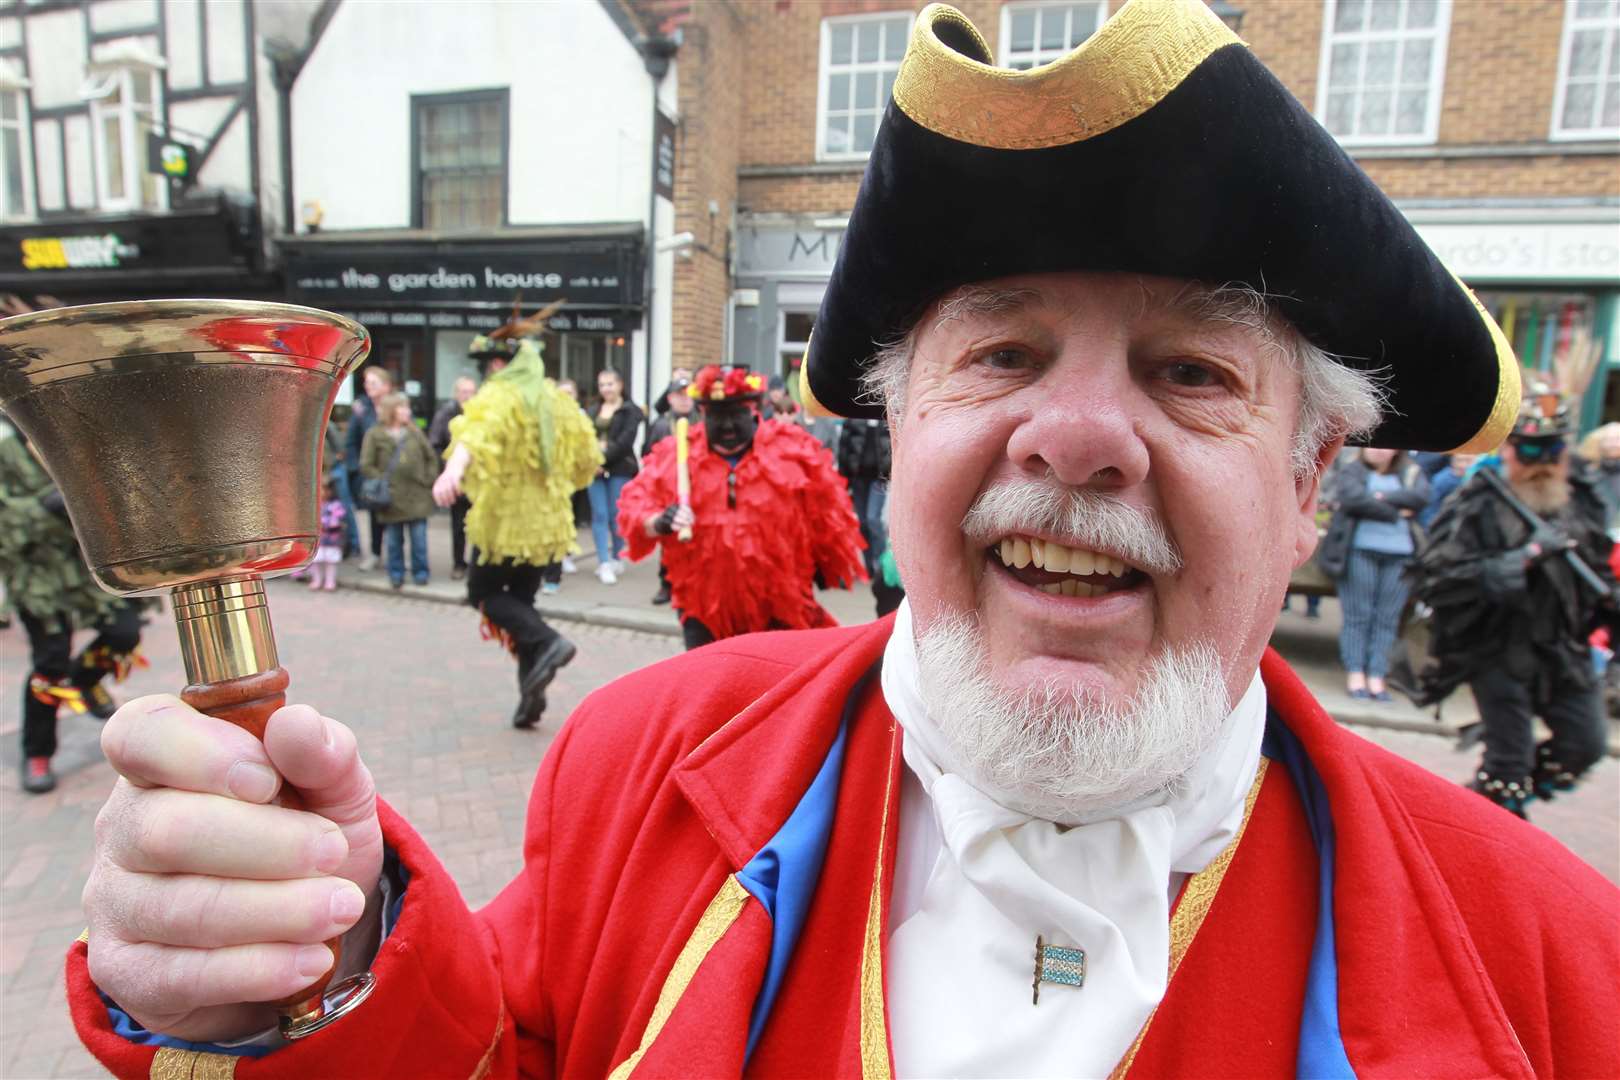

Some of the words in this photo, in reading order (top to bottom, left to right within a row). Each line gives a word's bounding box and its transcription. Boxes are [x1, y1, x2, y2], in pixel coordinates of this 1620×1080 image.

[21, 233, 119, 269] SUBWAY
[341, 267, 381, 288] the
[388, 267, 477, 293] garden
[484, 266, 563, 288] house
[577, 314, 614, 330] hams
